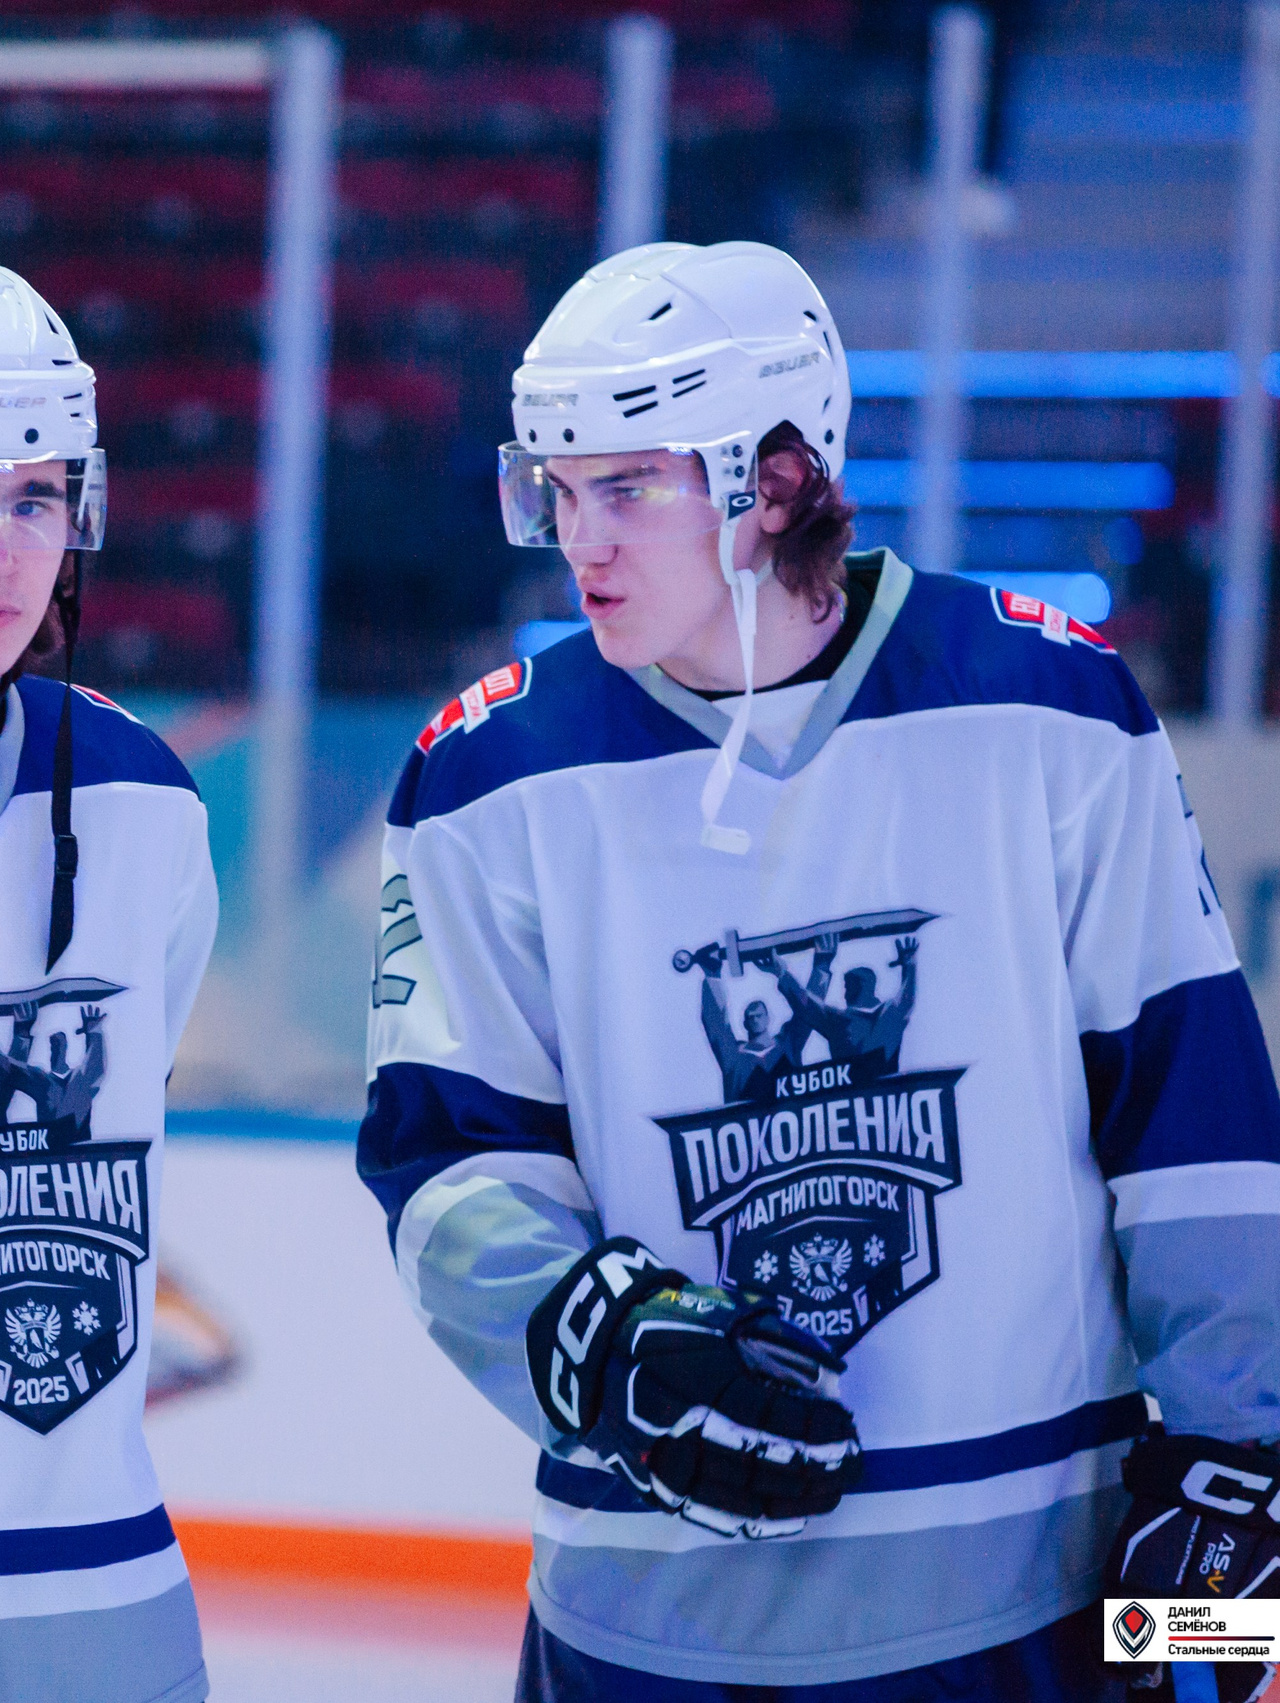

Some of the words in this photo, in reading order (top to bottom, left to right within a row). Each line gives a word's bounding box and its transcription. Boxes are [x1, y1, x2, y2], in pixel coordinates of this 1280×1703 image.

[776, 1064, 852, 1098] КУБОК
[680, 1088, 946, 1204] ПОКОЛЕНИЯ
[736, 1175, 900, 1236] МАГНИТОГОРСК
[550, 1247, 665, 1429] CCM
[13, 1374, 70, 1407] 2025
